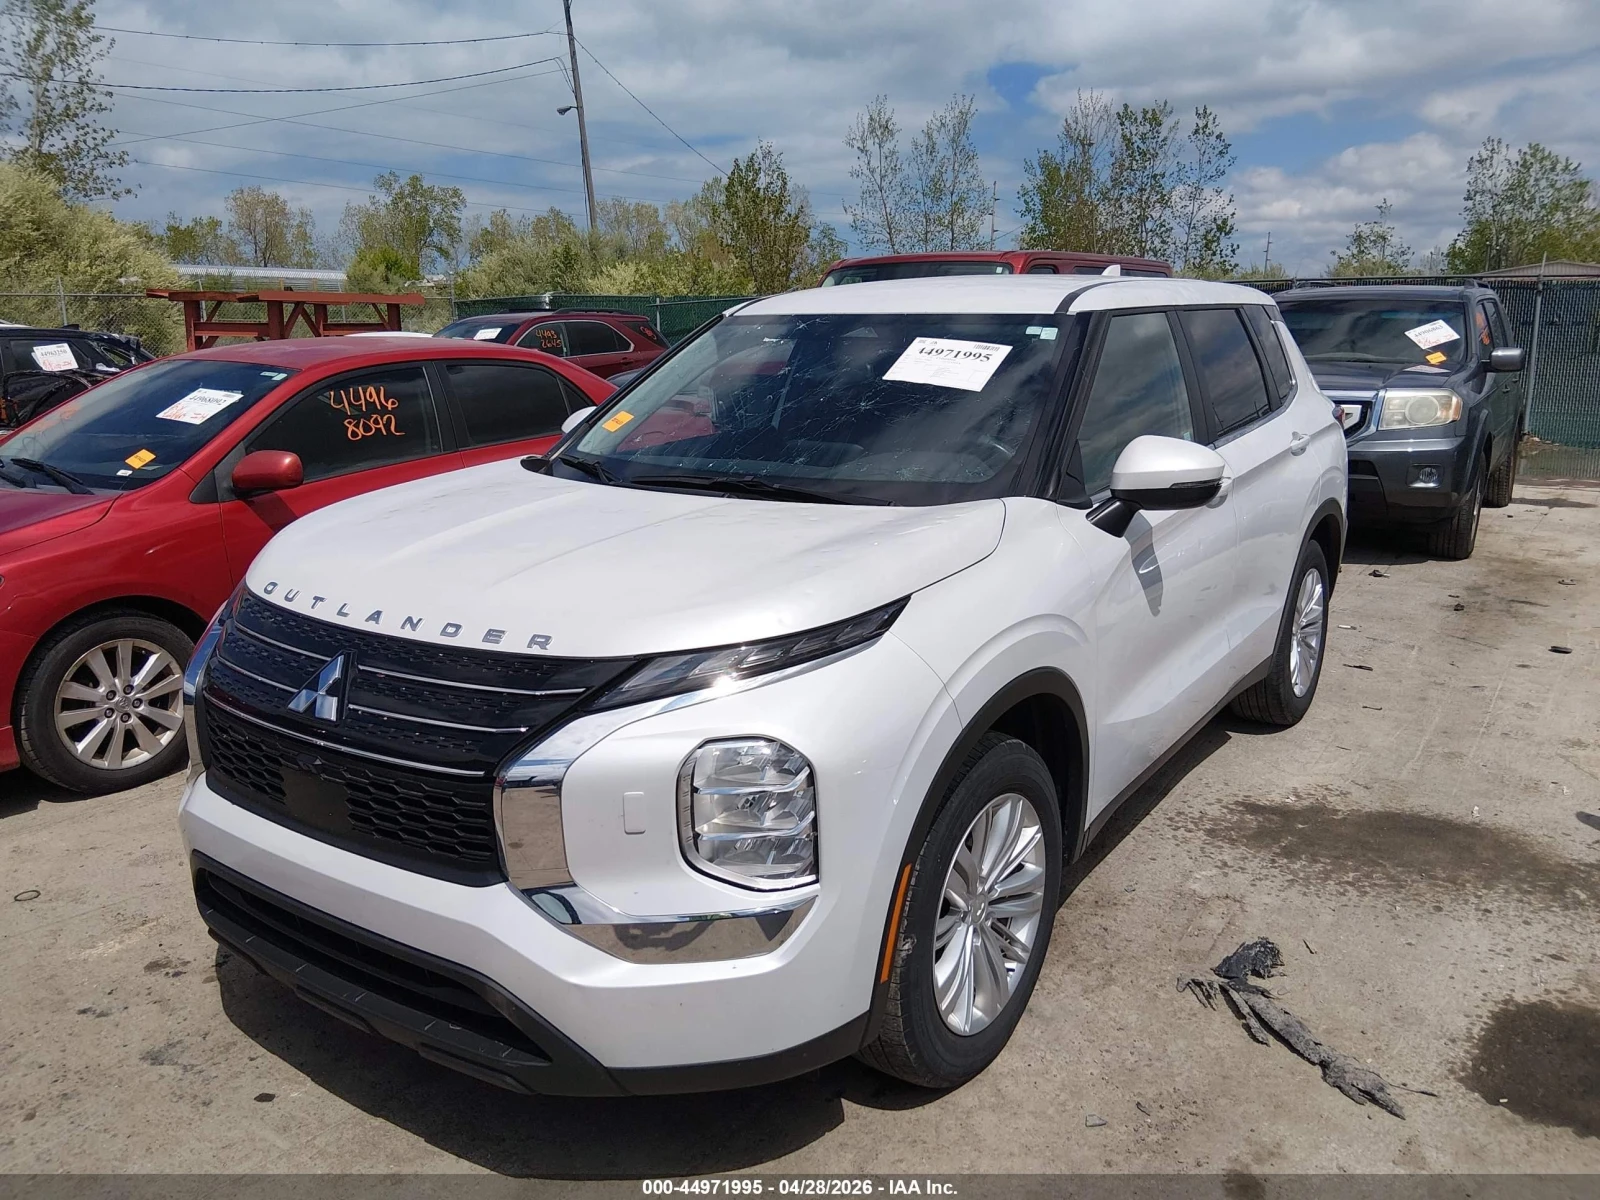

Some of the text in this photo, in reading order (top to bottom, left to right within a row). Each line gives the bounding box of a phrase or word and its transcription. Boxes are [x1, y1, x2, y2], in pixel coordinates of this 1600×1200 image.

[918, 346, 993, 362] 44971995
[330, 385, 399, 415] 4496
[343, 414, 406, 440] 8092
[263, 581, 553, 651] OUTLANDER
